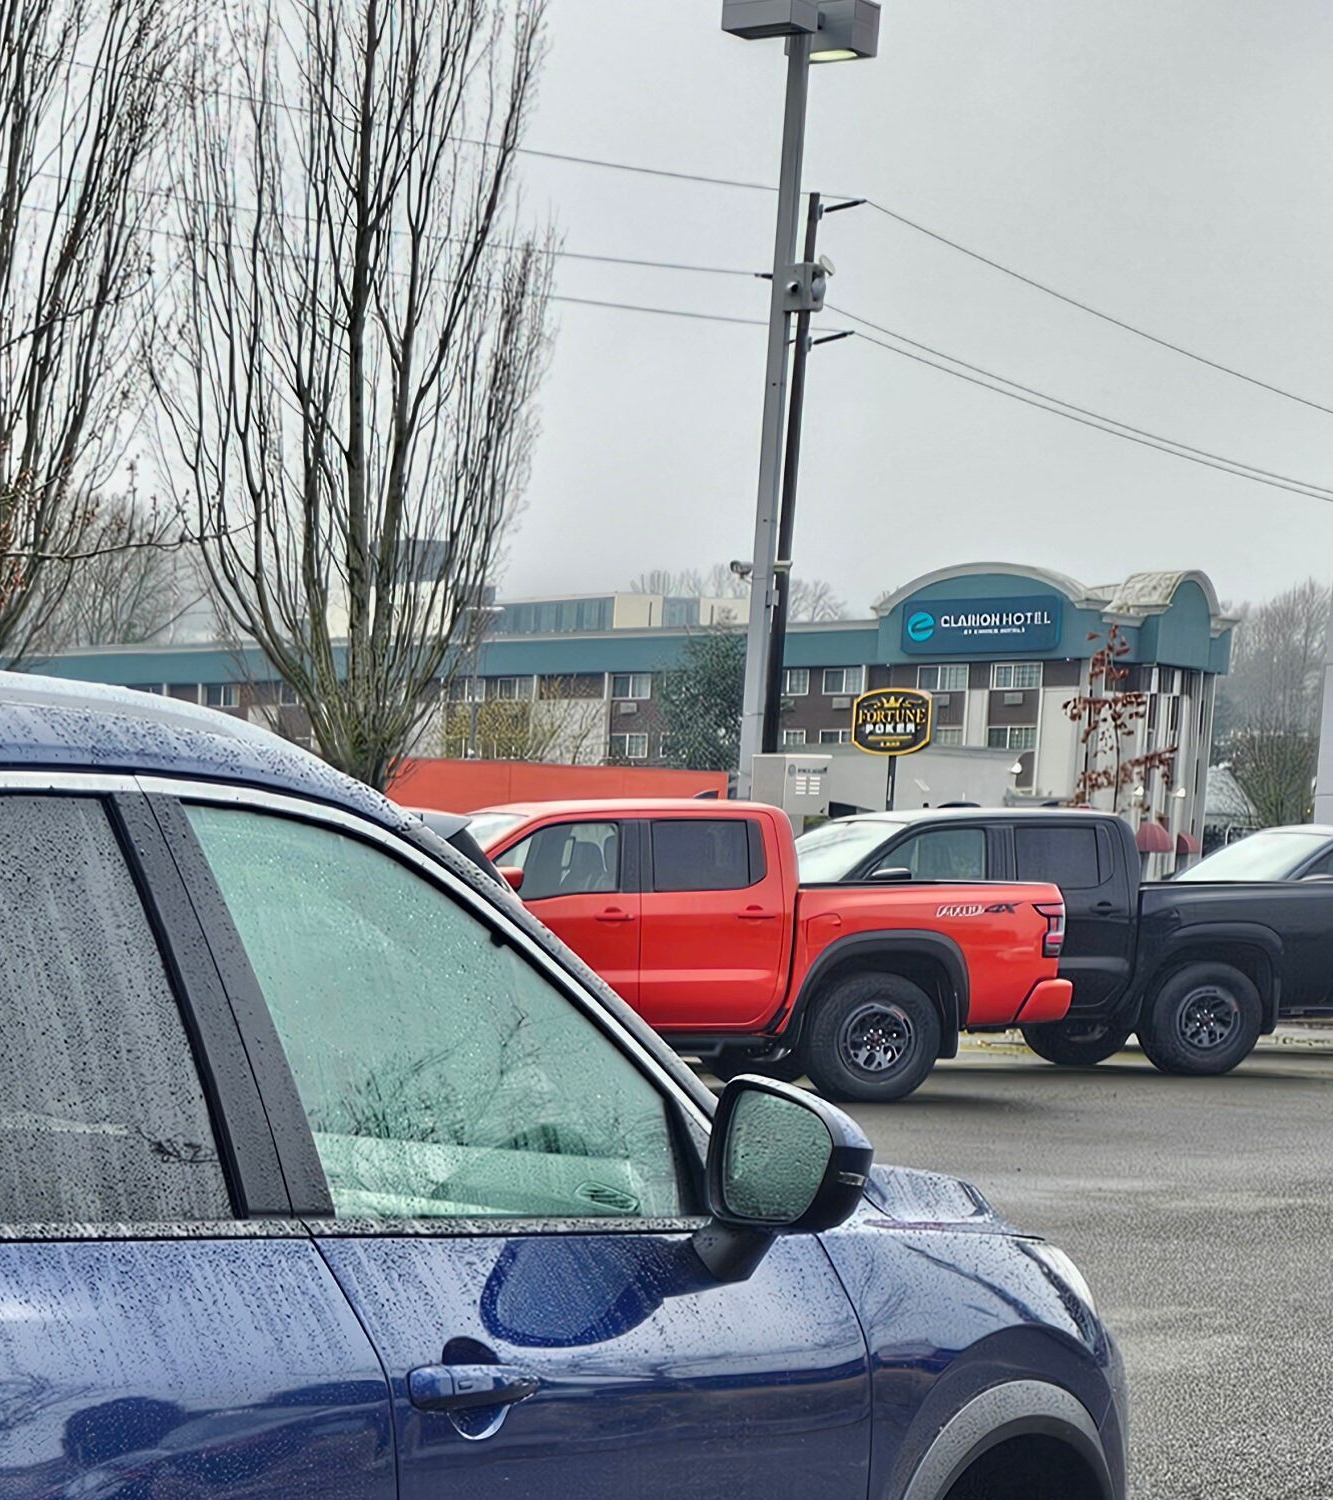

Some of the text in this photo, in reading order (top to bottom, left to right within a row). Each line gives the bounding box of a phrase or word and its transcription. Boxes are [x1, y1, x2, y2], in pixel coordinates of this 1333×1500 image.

[940, 611, 1051, 628] CLARION HOTEL
[858, 708, 926, 724] FORTUNE
[865, 722, 915, 734] POKER
